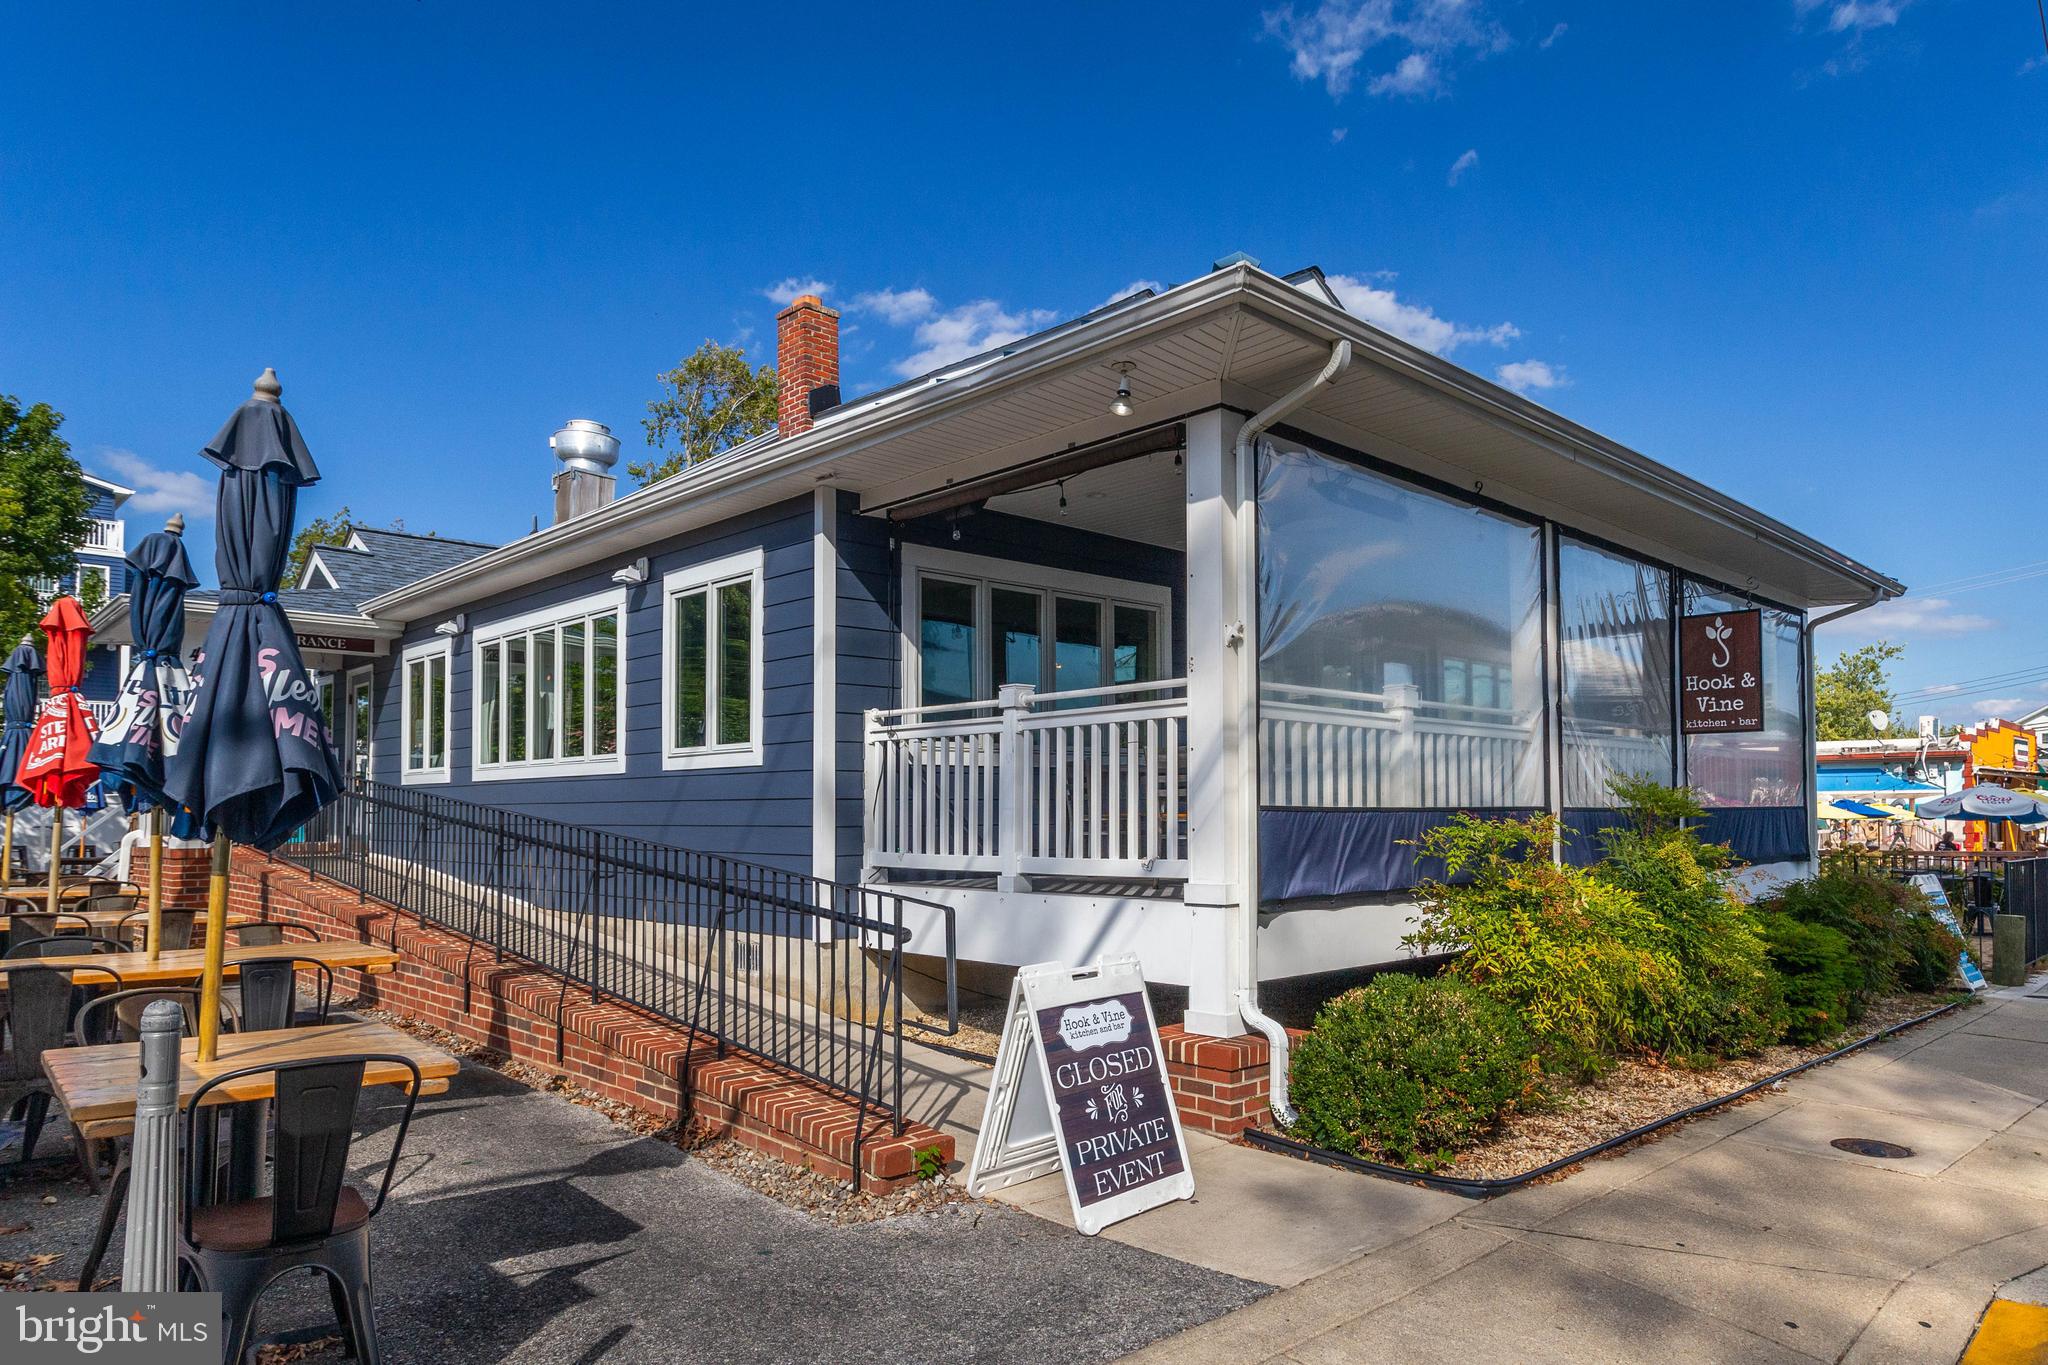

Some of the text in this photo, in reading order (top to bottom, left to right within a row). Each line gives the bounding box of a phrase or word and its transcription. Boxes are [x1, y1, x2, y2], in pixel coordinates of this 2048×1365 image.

[1686, 672, 1756, 691] Hook &
[1696, 696, 1744, 712] Vine
[1686, 717, 1758, 728] kitchen bar
[1064, 1011, 1126, 1031] Hook & Vine
[1070, 1022, 1125, 1040] kitchen and bar
[1056, 1046, 1153, 1089] CLOSED
[1101, 1083, 1128, 1123] FOR
[1075, 1117, 1169, 1166] PRIVATE
[1093, 1151, 1165, 1197] EVENT
